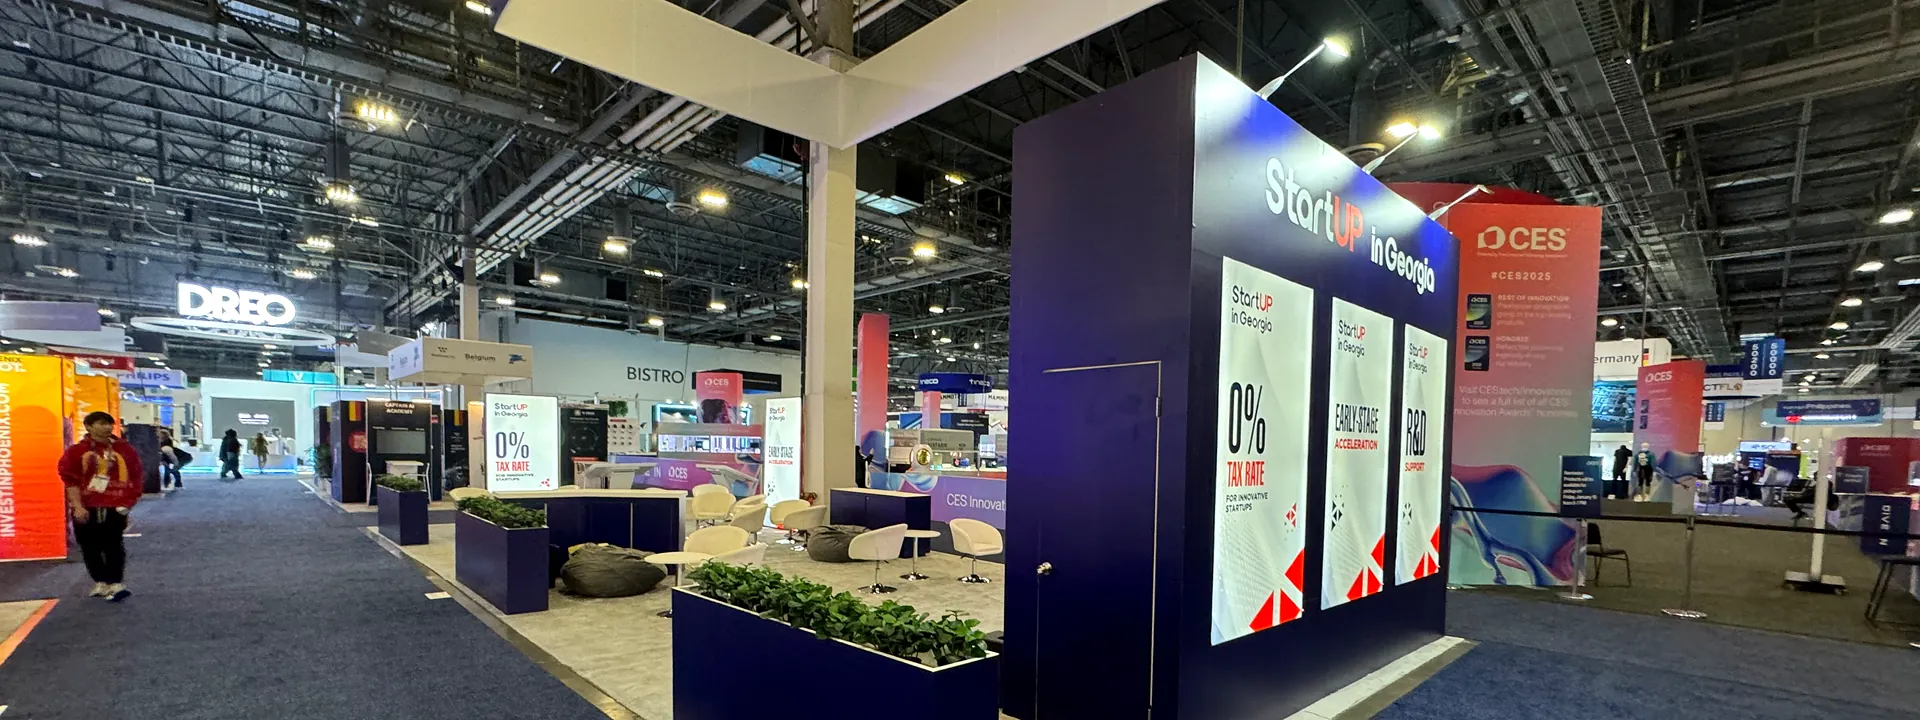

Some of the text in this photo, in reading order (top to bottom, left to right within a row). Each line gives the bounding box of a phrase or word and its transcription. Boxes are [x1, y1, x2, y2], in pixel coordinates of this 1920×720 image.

[1265, 157, 1435, 295] StartUP in Georgia
[1509, 227, 1566, 251] CES
[1491, 271, 1551, 281] #CES2025
[177, 283, 296, 326] DREO
[1232, 285, 1273, 312] StartUP
[1231, 308, 1272, 334] in Georgia
[1338, 320, 1366, 340] StartUP
[1338, 338, 1365, 358] in Georgia
[1409, 343, 1428, 359] StartUP
[465, 353, 496, 362] Belgium
[1750, 343, 1759, 377] 50200
[1768, 342, 1778, 376] 50000
[627, 367, 685, 384] BISTRO
[713, 378, 729, 386] CES
[1654, 371, 1673, 382] CES
[494, 402, 528, 411] StartUP
[1229, 382, 1266, 454] 0%
[1335, 403, 1379, 434] EARLY-STAGE
[1406, 407, 1427, 456] R&D
[495, 431, 529, 459] 0%
[1335, 438, 1378, 450] ACCELERATION
[496, 461, 530, 471] TAX RATE
[675, 466, 688, 479] CES
[1227, 461, 1265, 487] TAX RATE
[1405, 462, 1425, 472] SUPPORT
[946, 493, 967, 507] CES
[1226, 492, 1268, 503] FOR INNOVATIVE
[1225, 503, 1252, 513] STARTUPS
